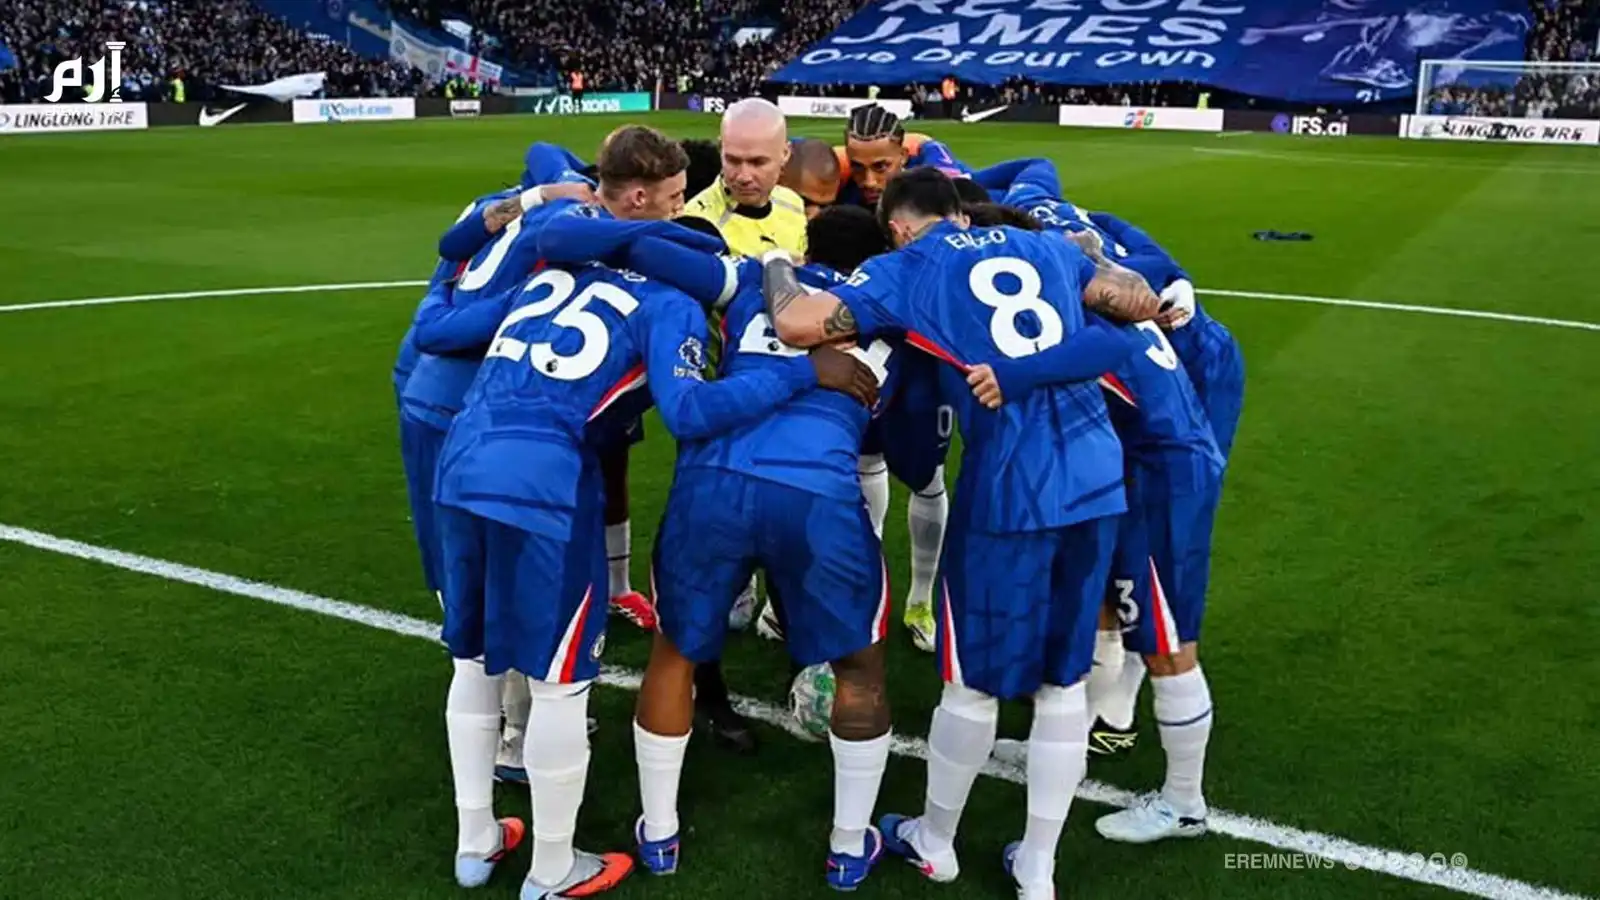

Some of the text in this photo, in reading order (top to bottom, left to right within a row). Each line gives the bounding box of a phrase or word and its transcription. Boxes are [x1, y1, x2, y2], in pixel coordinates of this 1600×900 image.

[832, 15, 1228, 46] JAMES
[14, 112, 95, 129] LINGLONG
[1292, 115, 1348, 137] IFS.ai
[1451, 122, 1537, 140] LINGNG
[969, 256, 1064, 359] 8
[485, 268, 640, 381] 25
[1114, 579, 1140, 623] 3
